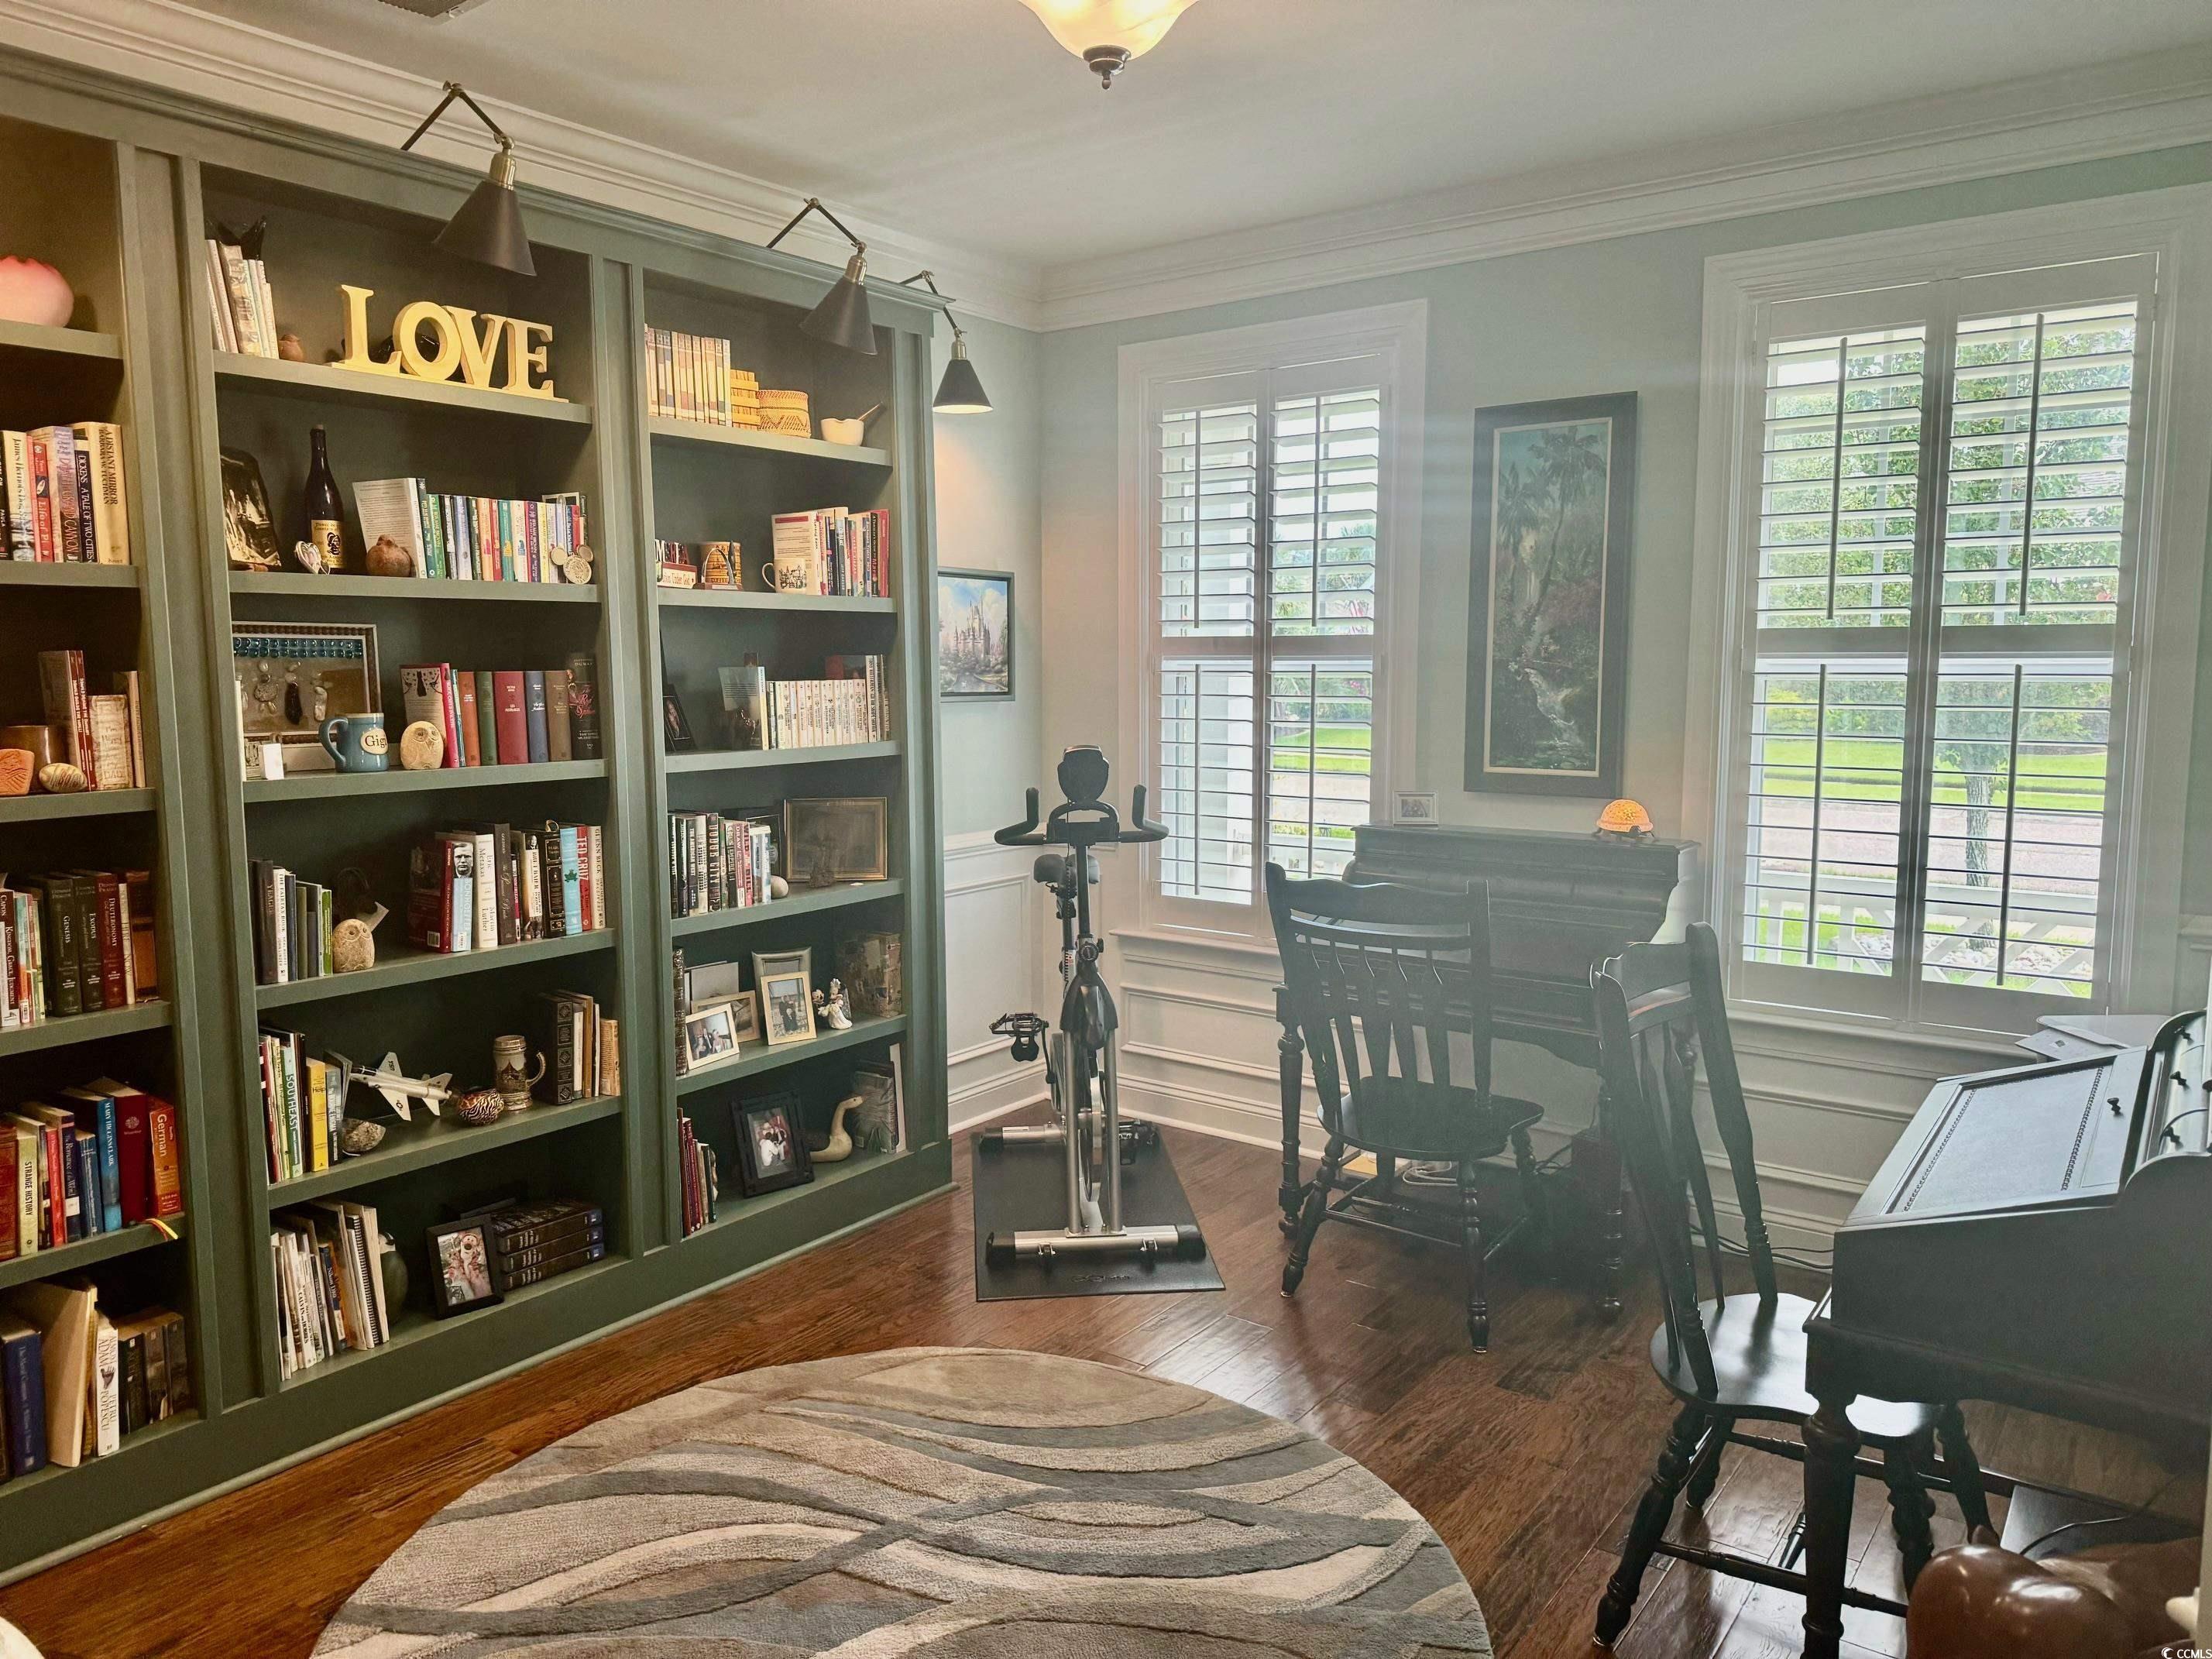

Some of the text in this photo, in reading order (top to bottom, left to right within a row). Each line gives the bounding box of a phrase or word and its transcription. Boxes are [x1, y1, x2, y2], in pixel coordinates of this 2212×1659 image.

[342, 284, 554, 391] LOVE
[98, 429, 107, 459] BARBARA
[106, 437, 115, 469] DISTANT
[78, 455, 88, 483] DICKENS
[81, 493, 91, 510] TALE
[109, 472, 118, 506] MIRROR
[39, 501, 49, 543] Life of Pi
[83, 510, 92, 520] OF
[84, 521, 94, 538] TWO
[64, 520, 78, 552] CANYON
[85, 538, 94, 559] CITIES
[365, 735, 387, 748] Gigi
[577, 836, 589, 881] TED CRUZ
[709, 825, 720, 884] DODGE CITY
[108, 898, 118, 946] DEUTERONOMY
[286, 1075, 298, 1130] SOUTHEAST
[105, 1121, 113, 1146] HIGGINS
[157, 1114, 167, 1157] German
[65, 1142, 74, 1170] Romance
[25, 1162, 33, 1216] STRANGE HISTORY
[67, 1180, 76, 1197] Word
[98, 1338, 110, 1368] ADAM
[100, 1390, 109, 1431] POPESCU
[108, 1394, 117, 1423] PETRU
